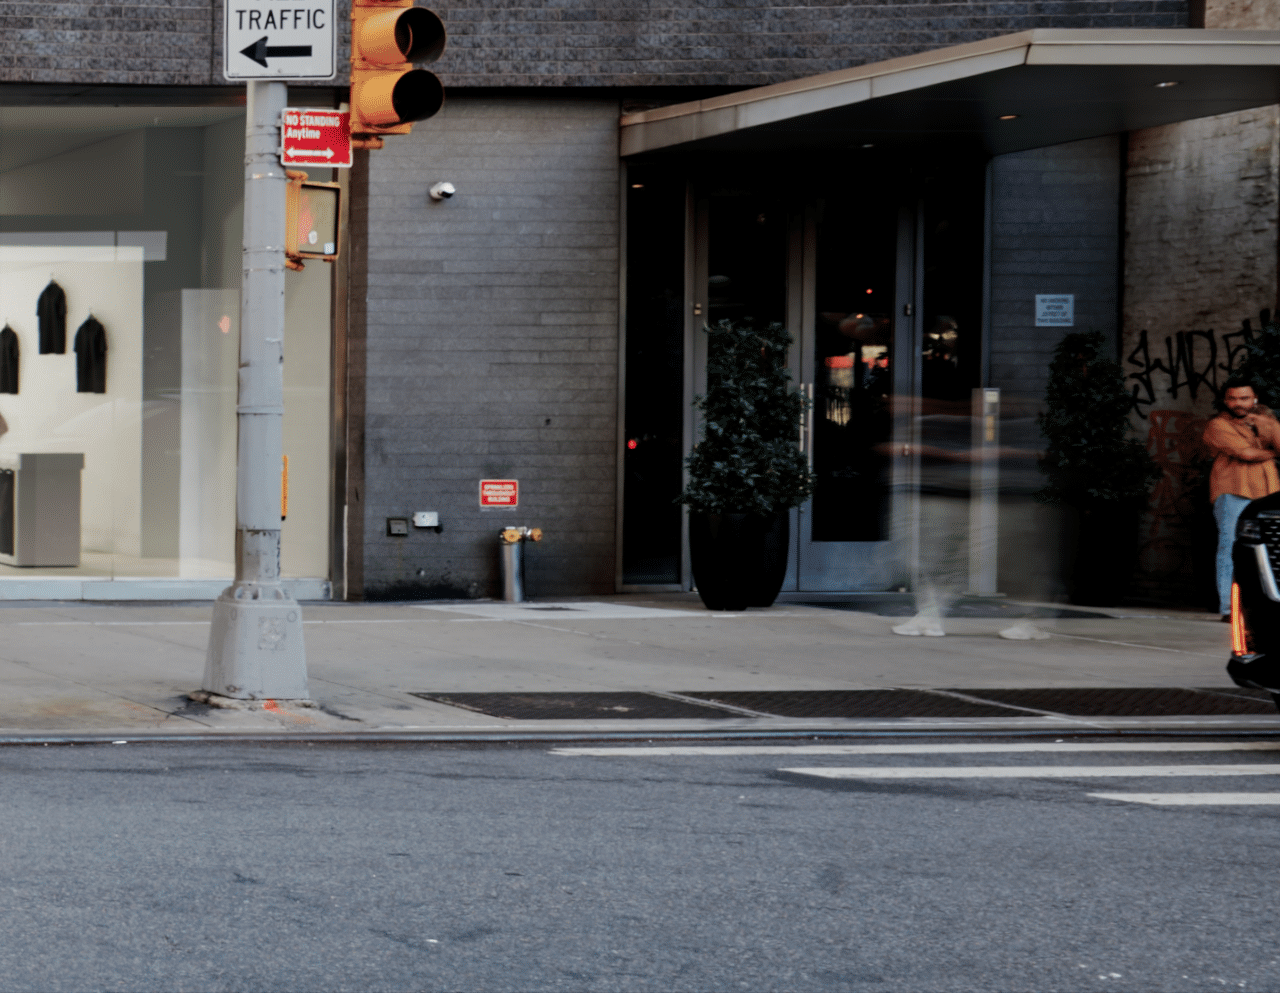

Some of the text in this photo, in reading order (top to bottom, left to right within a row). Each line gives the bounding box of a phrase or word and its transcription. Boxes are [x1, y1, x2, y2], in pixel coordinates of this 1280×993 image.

[235, 8, 326, 30] TRAFFIC
[286, 114, 340, 127] NO STANDING
[286, 127, 321, 141] Anytime
